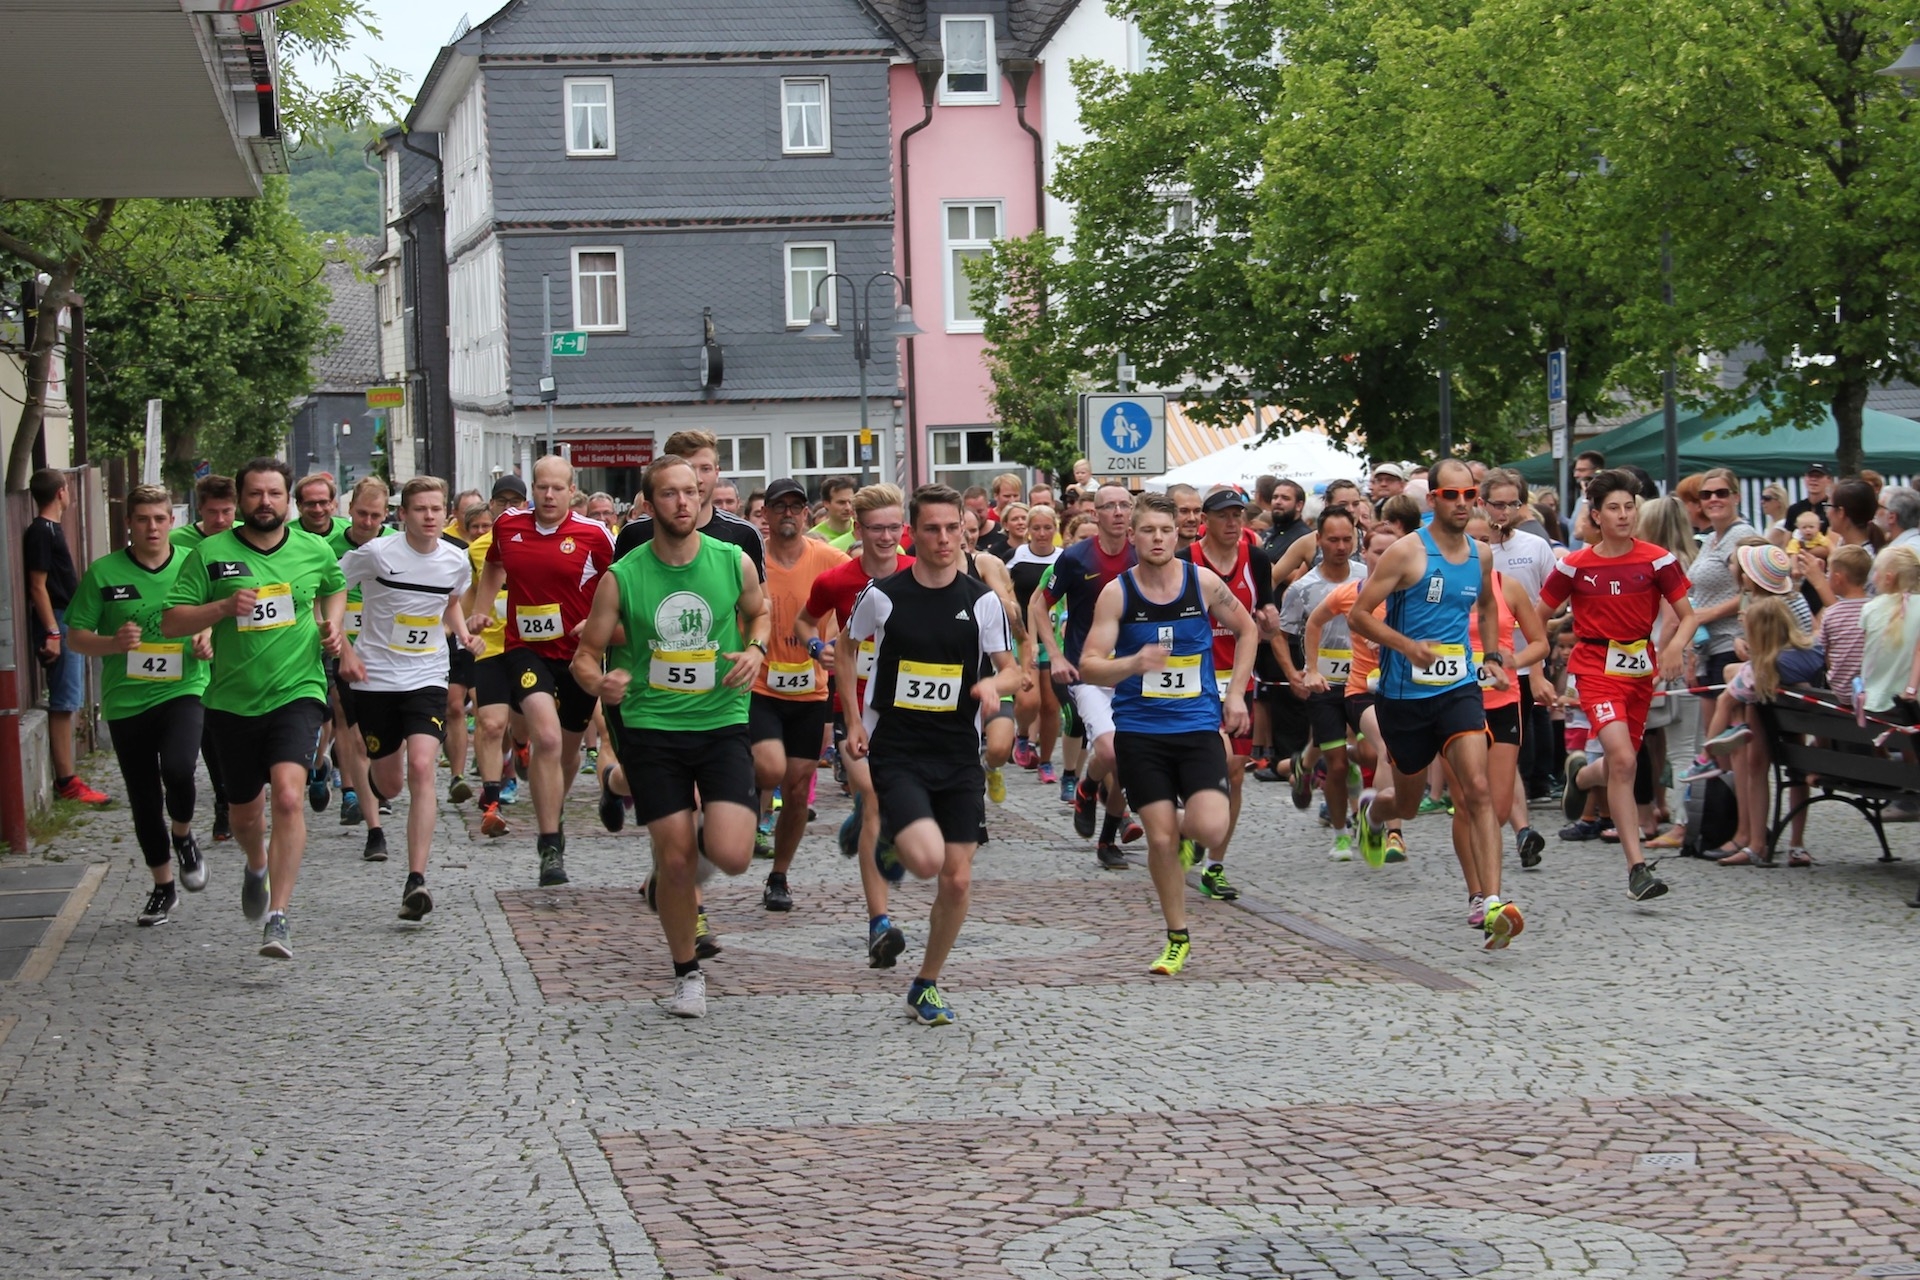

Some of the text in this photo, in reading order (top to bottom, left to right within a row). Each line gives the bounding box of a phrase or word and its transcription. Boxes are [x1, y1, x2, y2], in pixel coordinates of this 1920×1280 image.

[578, 454, 650, 464] bei Saring in Haiger
[1108, 457, 1146, 470] ZONE
[1508, 557, 1533, 566] CLOOS
[1609, 581, 1621, 595] TC
[253, 602, 277, 621] 36
[523, 618, 555, 634] 284
[406, 630, 429, 645] 52
[142, 658, 167, 672] 42
[1422, 660, 1458, 676] 103
[1616, 653, 1646, 670] 226
[668, 667, 697, 684] 55
[775, 674, 809, 688] 143
[1160, 672, 1186, 689] 31
[906, 680, 951, 701] 320
